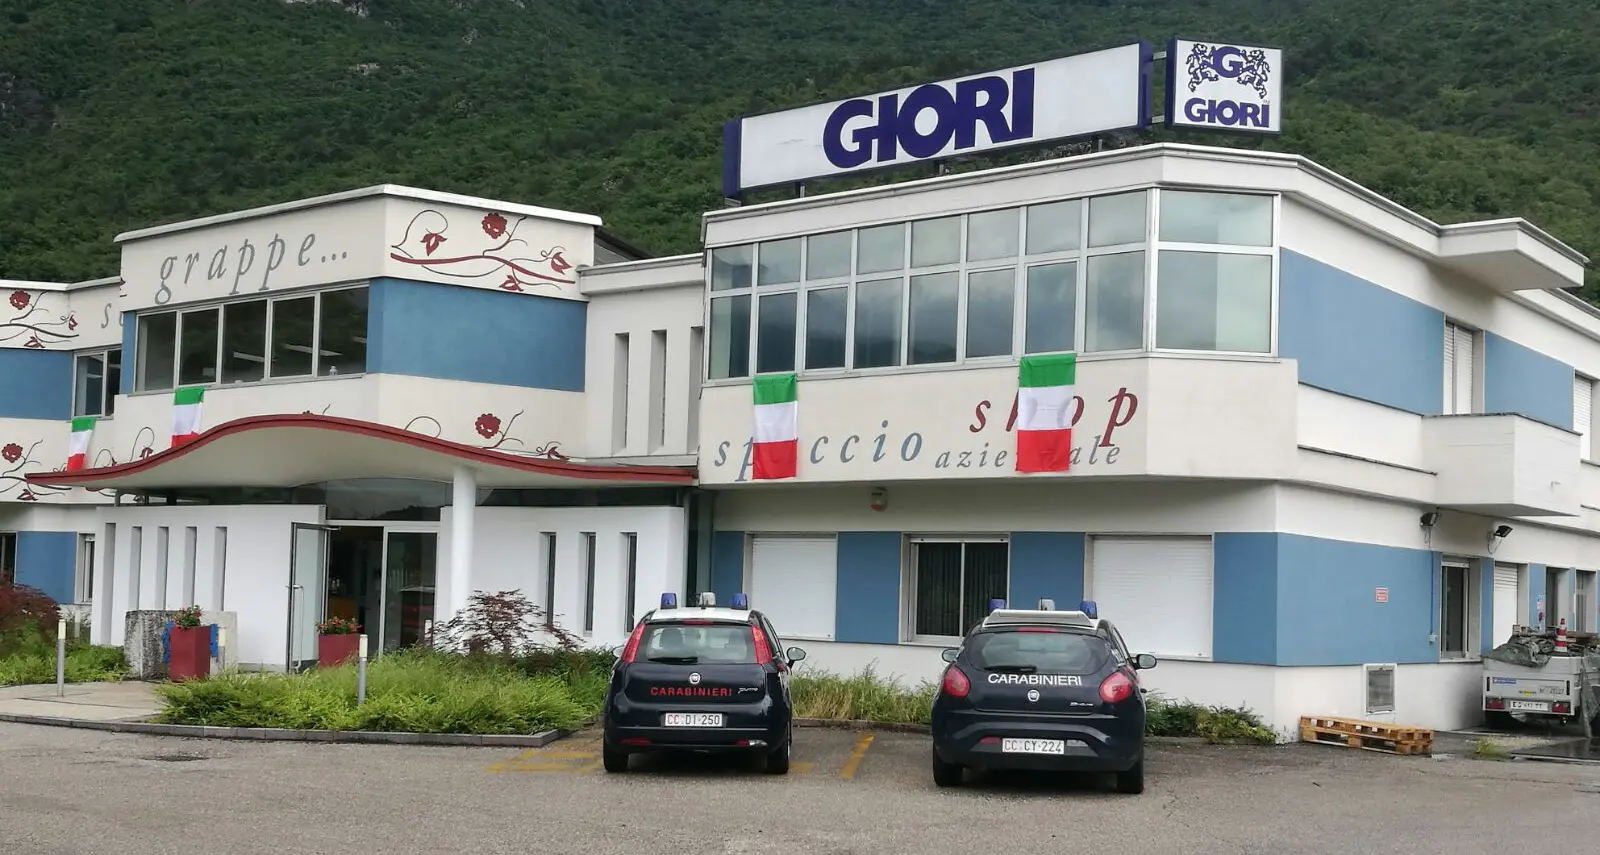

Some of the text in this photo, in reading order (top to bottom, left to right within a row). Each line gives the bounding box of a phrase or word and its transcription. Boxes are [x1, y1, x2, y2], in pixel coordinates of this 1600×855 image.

[823, 67, 1035, 169] GIORI
[1184, 97, 1270, 128] GIORI
[154, 233, 347, 304] grappe...
[714, 420, 1121, 482] spccio azieale
[650, 687, 733, 697] CARABINIERI
[988, 673, 1082, 686] CARABINIERI
